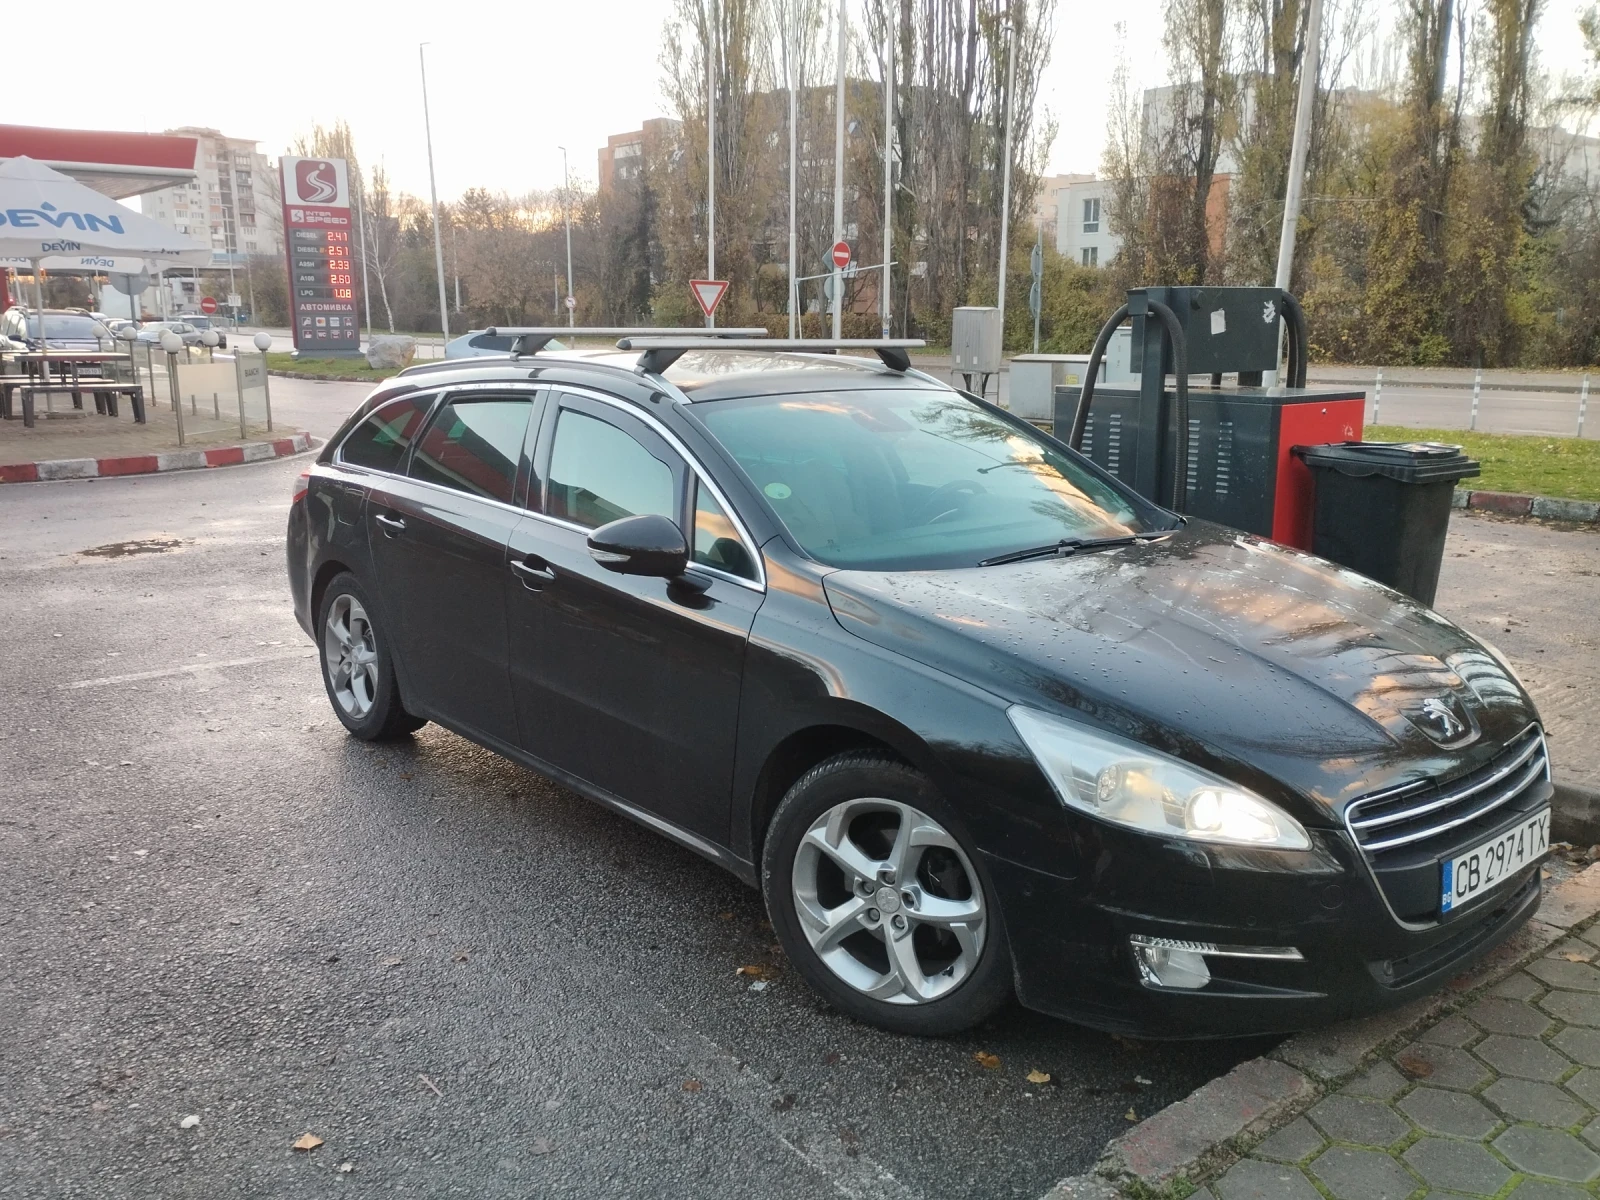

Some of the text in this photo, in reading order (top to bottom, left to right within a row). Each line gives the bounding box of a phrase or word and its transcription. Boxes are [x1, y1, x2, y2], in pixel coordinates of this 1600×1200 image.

[305, 216, 348, 224] SPEED
[41, 240, 81, 252] DEVIN
[329, 260, 350, 270] 2.33
[330, 274, 351, 284] 2.60
[300, 303, 353, 311] АВТОМИВКА
[1456, 814, 1548, 899] CB 2974 TX
[1442, 891, 1452, 906] BG
